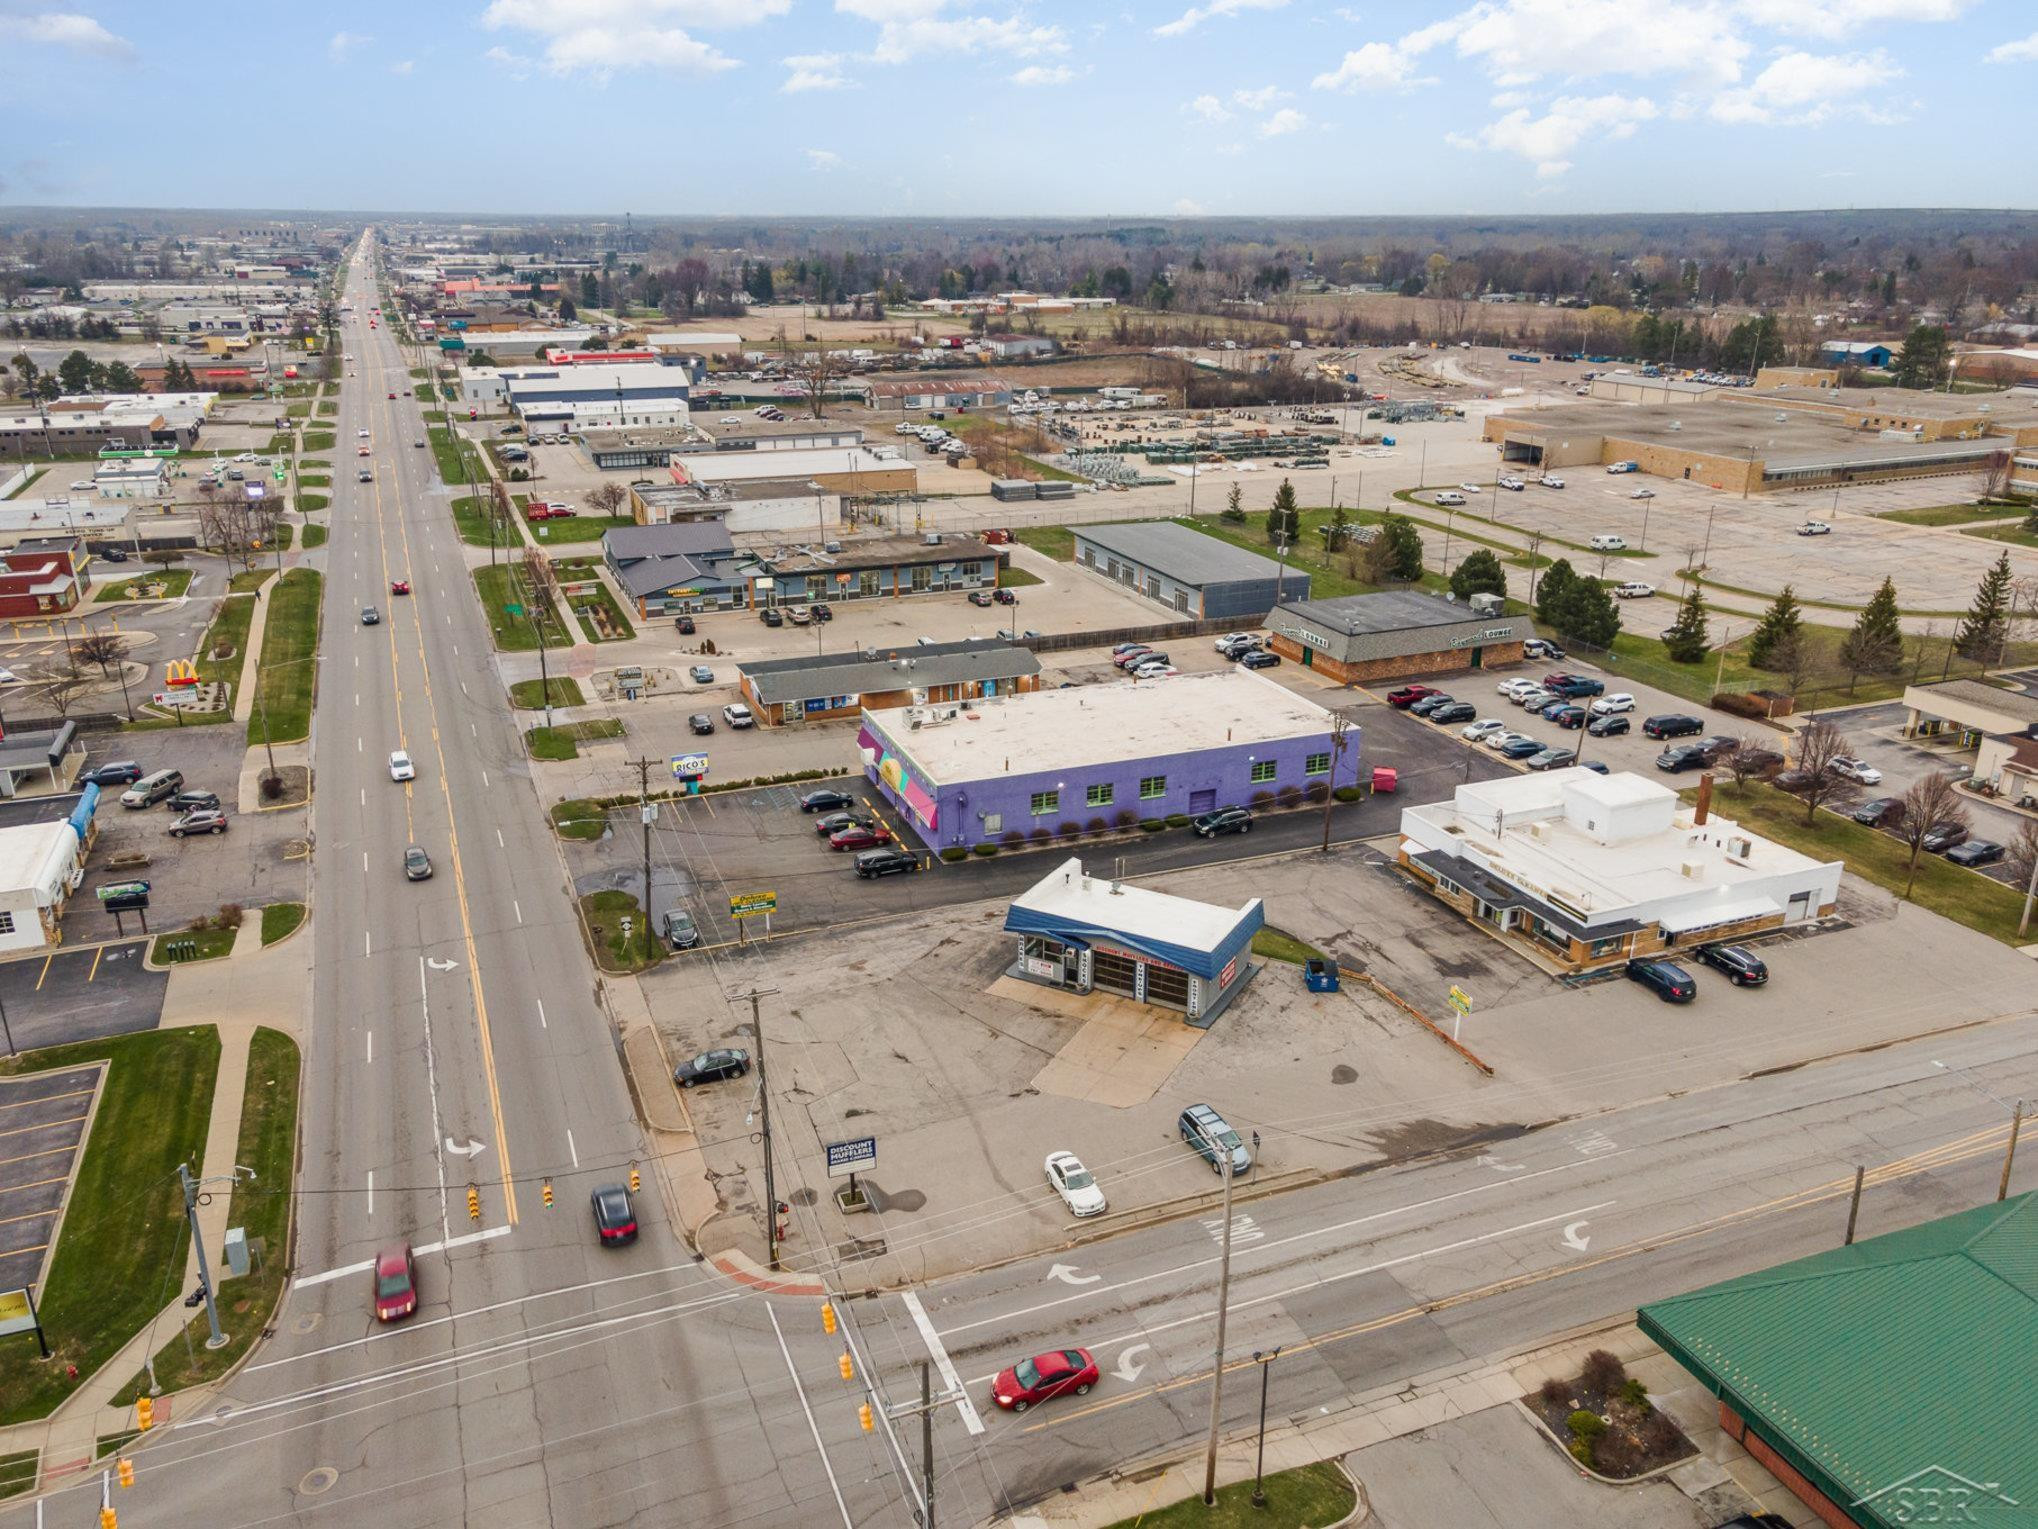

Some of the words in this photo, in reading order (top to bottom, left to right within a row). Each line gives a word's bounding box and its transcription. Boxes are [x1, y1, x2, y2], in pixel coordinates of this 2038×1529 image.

[1301, 629, 1329, 647] LOUNGE
[1484, 629, 1512, 639] LOUNGE
[676, 759, 705, 773] RICO'S
[830, 1140, 873, 1154] DISCOUNT
[830, 1147, 873, 1160] MUFFLERS
